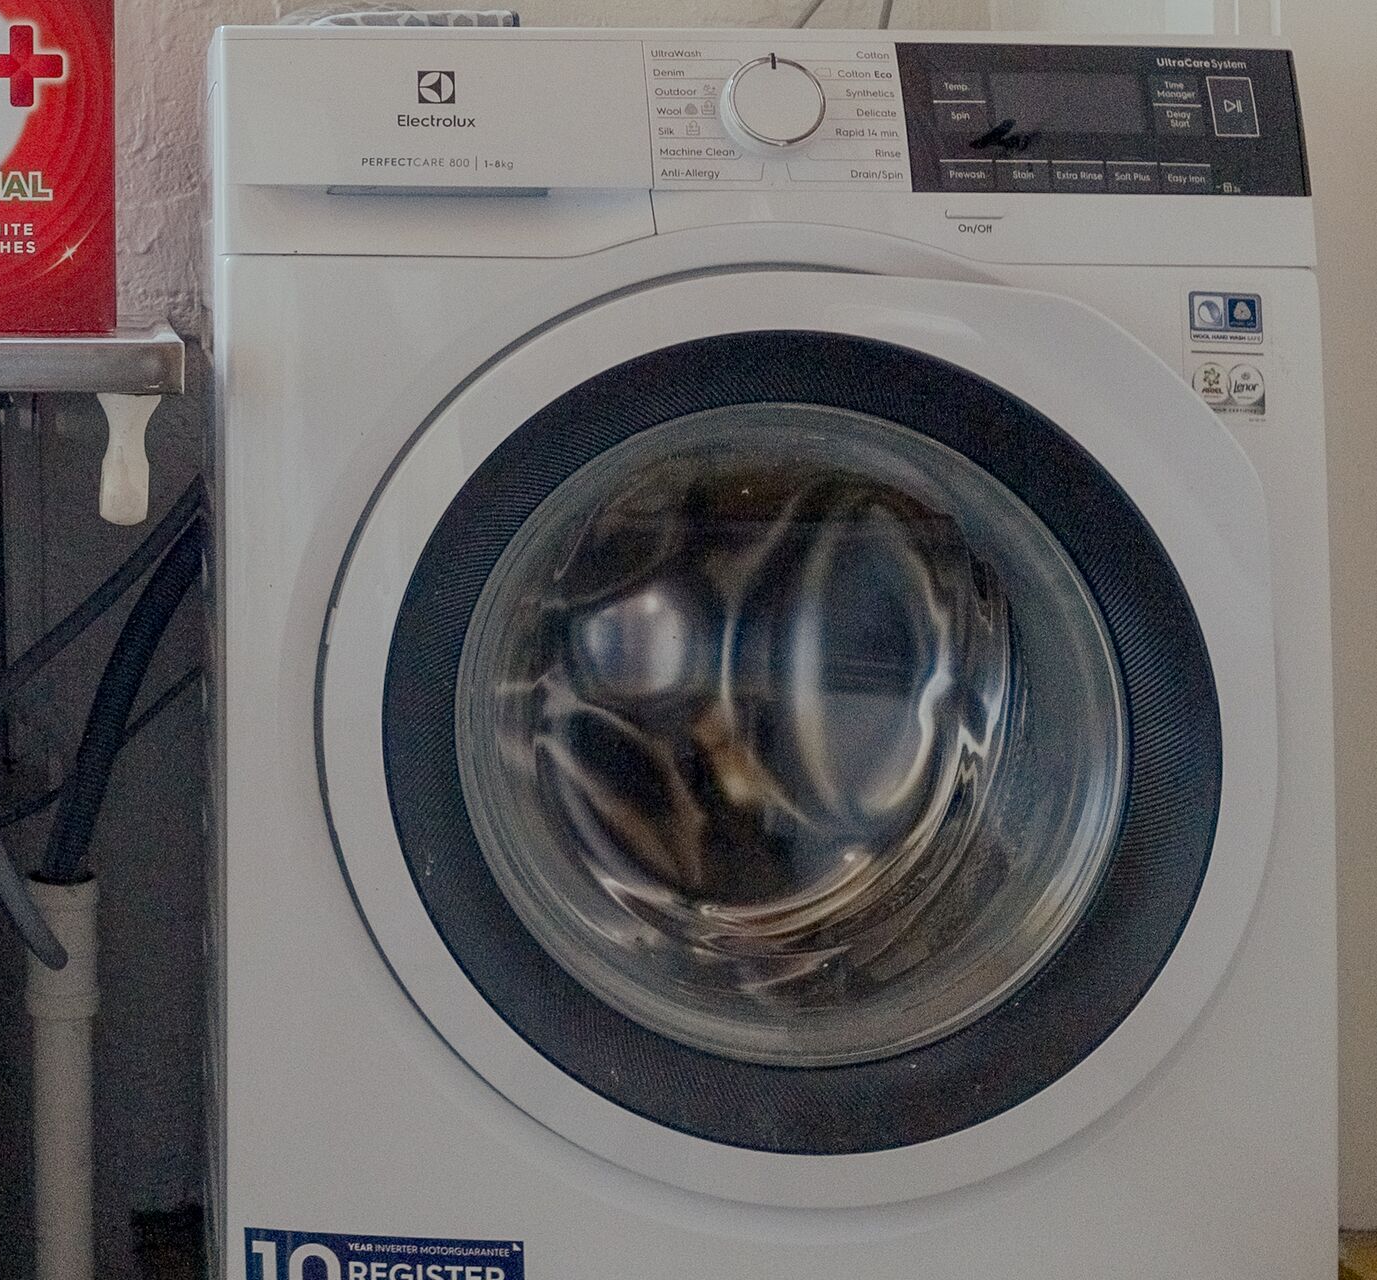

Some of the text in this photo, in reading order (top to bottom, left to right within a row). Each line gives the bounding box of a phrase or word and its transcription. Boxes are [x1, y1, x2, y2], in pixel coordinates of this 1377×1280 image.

[651, 49, 702, 58] UltraWash
[856, 51, 890, 60] Cotton
[653, 68, 685, 77] Denim
[837, 70, 893, 79] Cotton Eco
[1164, 81, 1184, 90] Time
[655, 87, 697, 96] Outdoor
[845, 88, 895, 99] Synthetics
[1157, 90, 1196, 100] Manager
[656, 106, 682, 116] Wool
[856, 108, 897, 118] Delicate
[950, 111, 971, 120] Spin
[1166, 110, 1191, 120] Delay
[398, 114, 476, 129] Electrolux
[1170, 120, 1191, 128] Start
[658, 126, 675, 136] Silk
[835, 127, 865, 139] Rapid
[867, 128, 878, 137] 14
[659, 147, 736, 157] Machine Clean
[875, 148, 902, 158] Rinse
[361, 157, 514, 171] PERFECTCARE 800 1-8kg
[660, 168, 721, 180] Anti-Allergy
[850, 169, 904, 180] Drain/Spin
[949, 170, 986, 179] Prewash
[1012, 170, 1035, 179] Stain
[1056, 171, 1104, 181] Extra Rinse
[1114, 172, 1151, 182] Soft Plus
[1167, 174, 1206, 184] Easy Iron
[957, 223, 993, 234] On/Off
[1233, 379, 1259, 394] Lenor
[348, 1242, 510, 1258] YEAR INVERTER MOTORGUARANTEE
